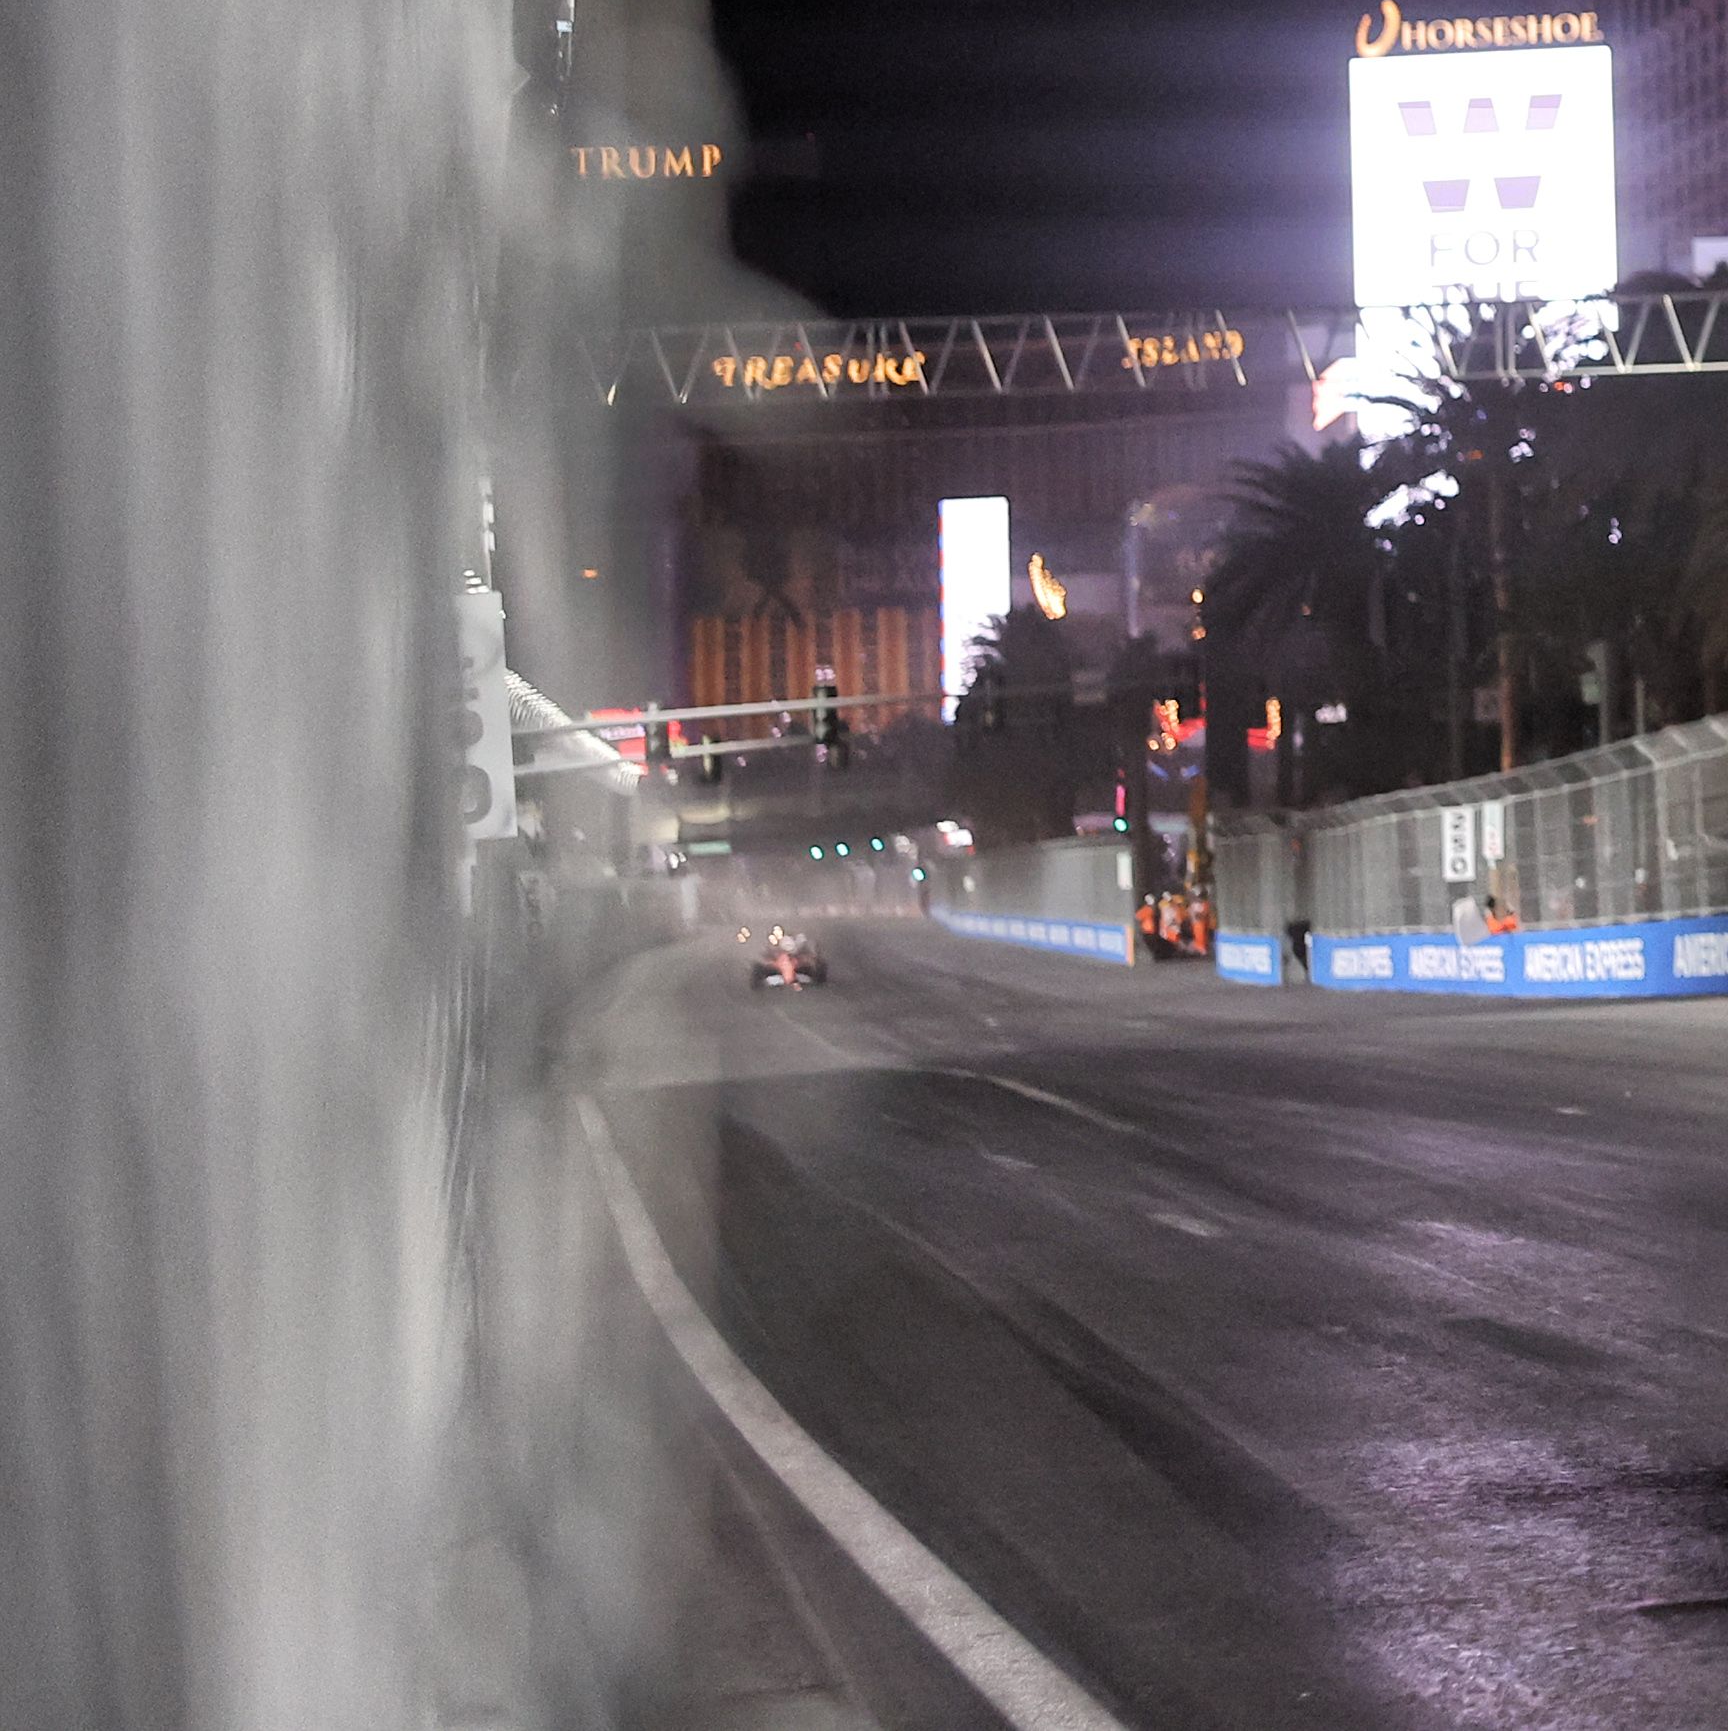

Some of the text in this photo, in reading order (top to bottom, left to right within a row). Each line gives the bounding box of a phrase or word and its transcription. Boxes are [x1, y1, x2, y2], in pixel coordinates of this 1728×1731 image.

[1401, 11, 1604, 51] HORSESHOE
[571, 143, 723, 179] TRUMP
[1430, 229, 1540, 267] FOR
[712, 350, 927, 390] TREASURE
